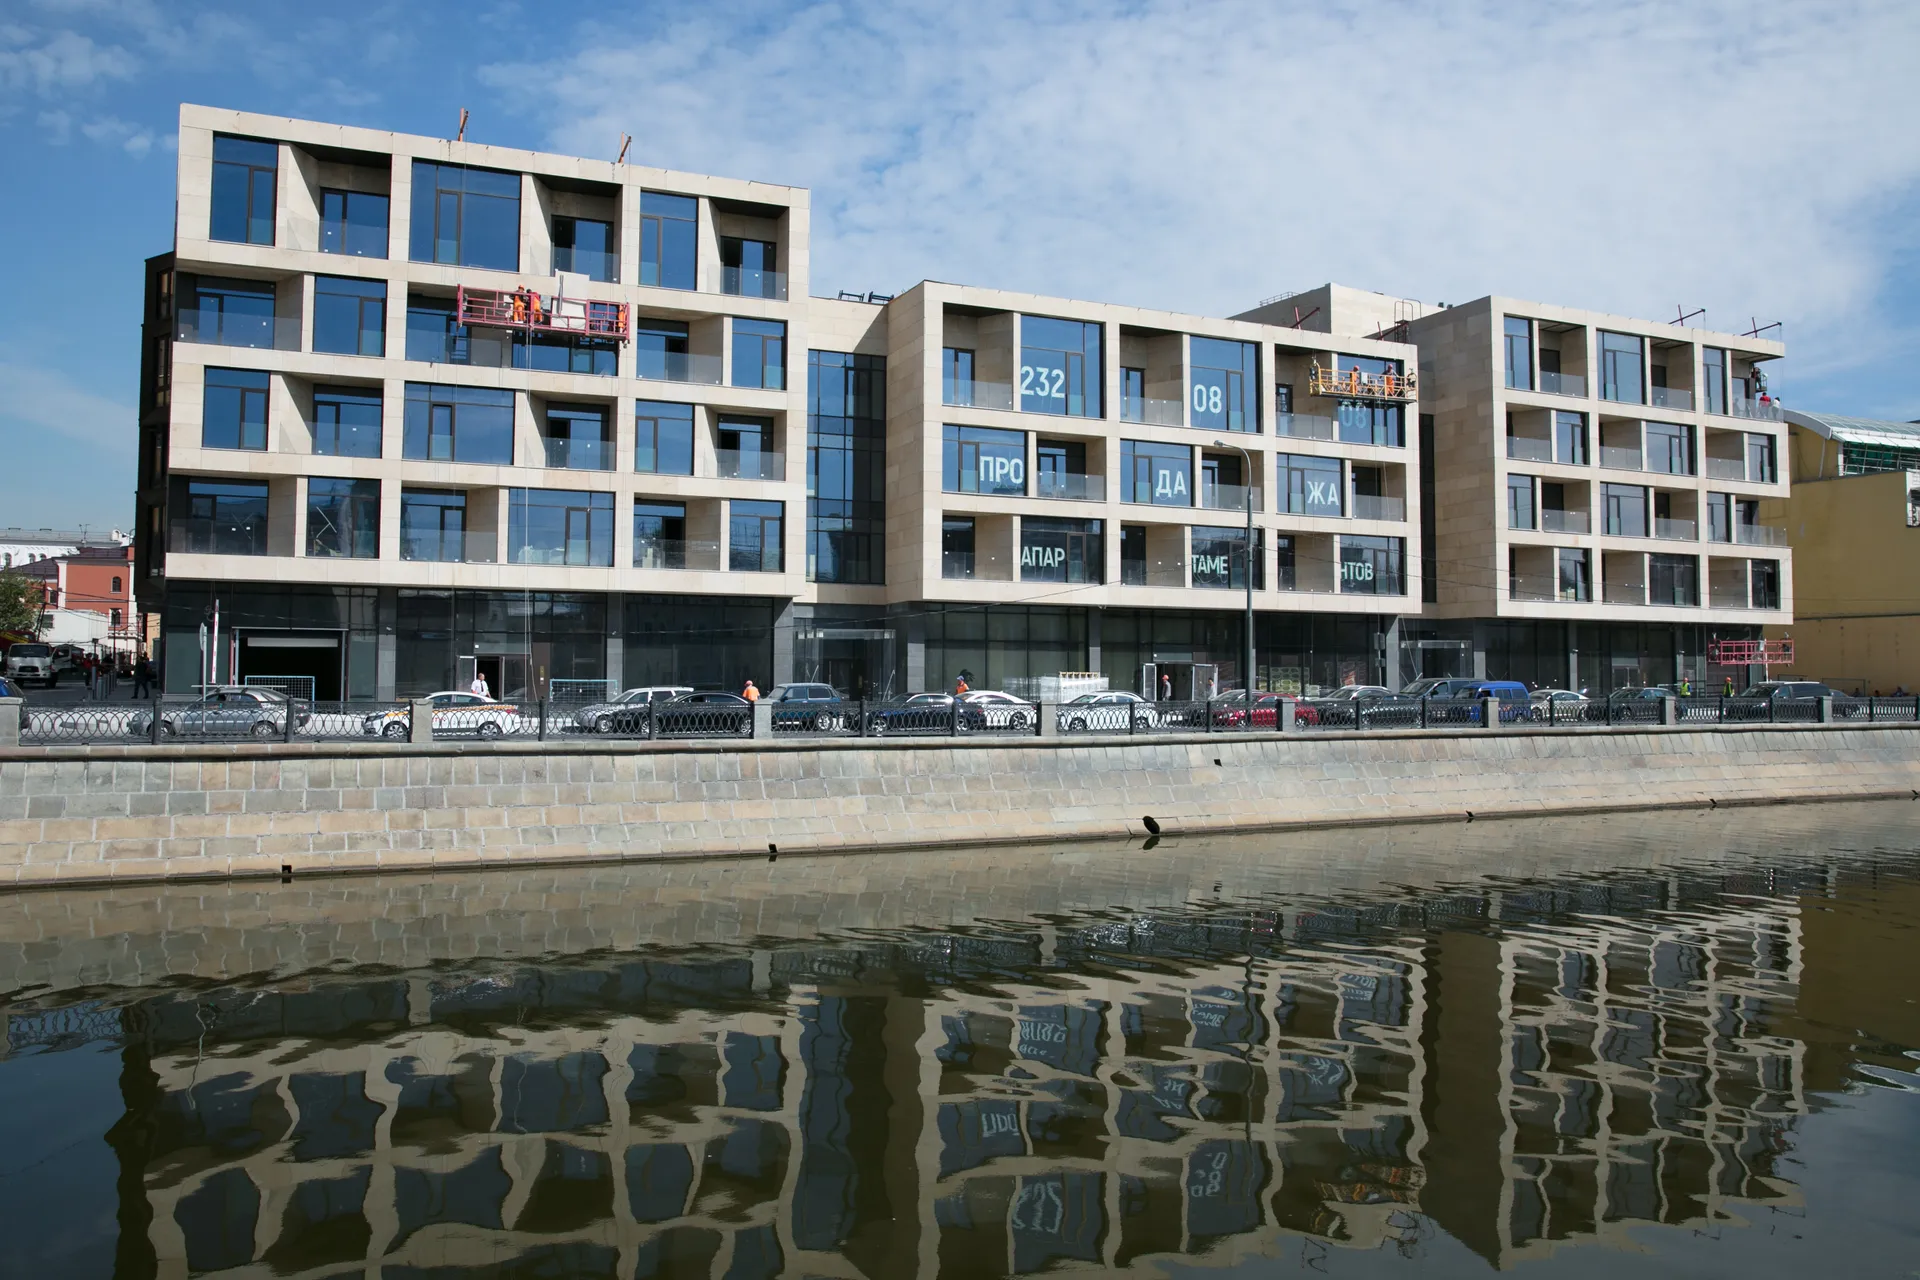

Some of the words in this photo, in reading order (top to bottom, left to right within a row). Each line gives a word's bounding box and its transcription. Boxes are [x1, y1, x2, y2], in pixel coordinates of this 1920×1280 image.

[1020, 366, 1065, 398] 232
[1193, 384, 1222, 414] 08
[1341, 401, 1367, 428] 08
[979, 456, 1024, 484] ПРО
[1155, 470, 1187, 498] ДА
[1307, 481, 1339, 506] ЖА
[1021, 546, 1065, 568] АПАР
[1191, 555, 1229, 575] ТАМЕ
[1340, 562, 1374, 581] НТОВ
